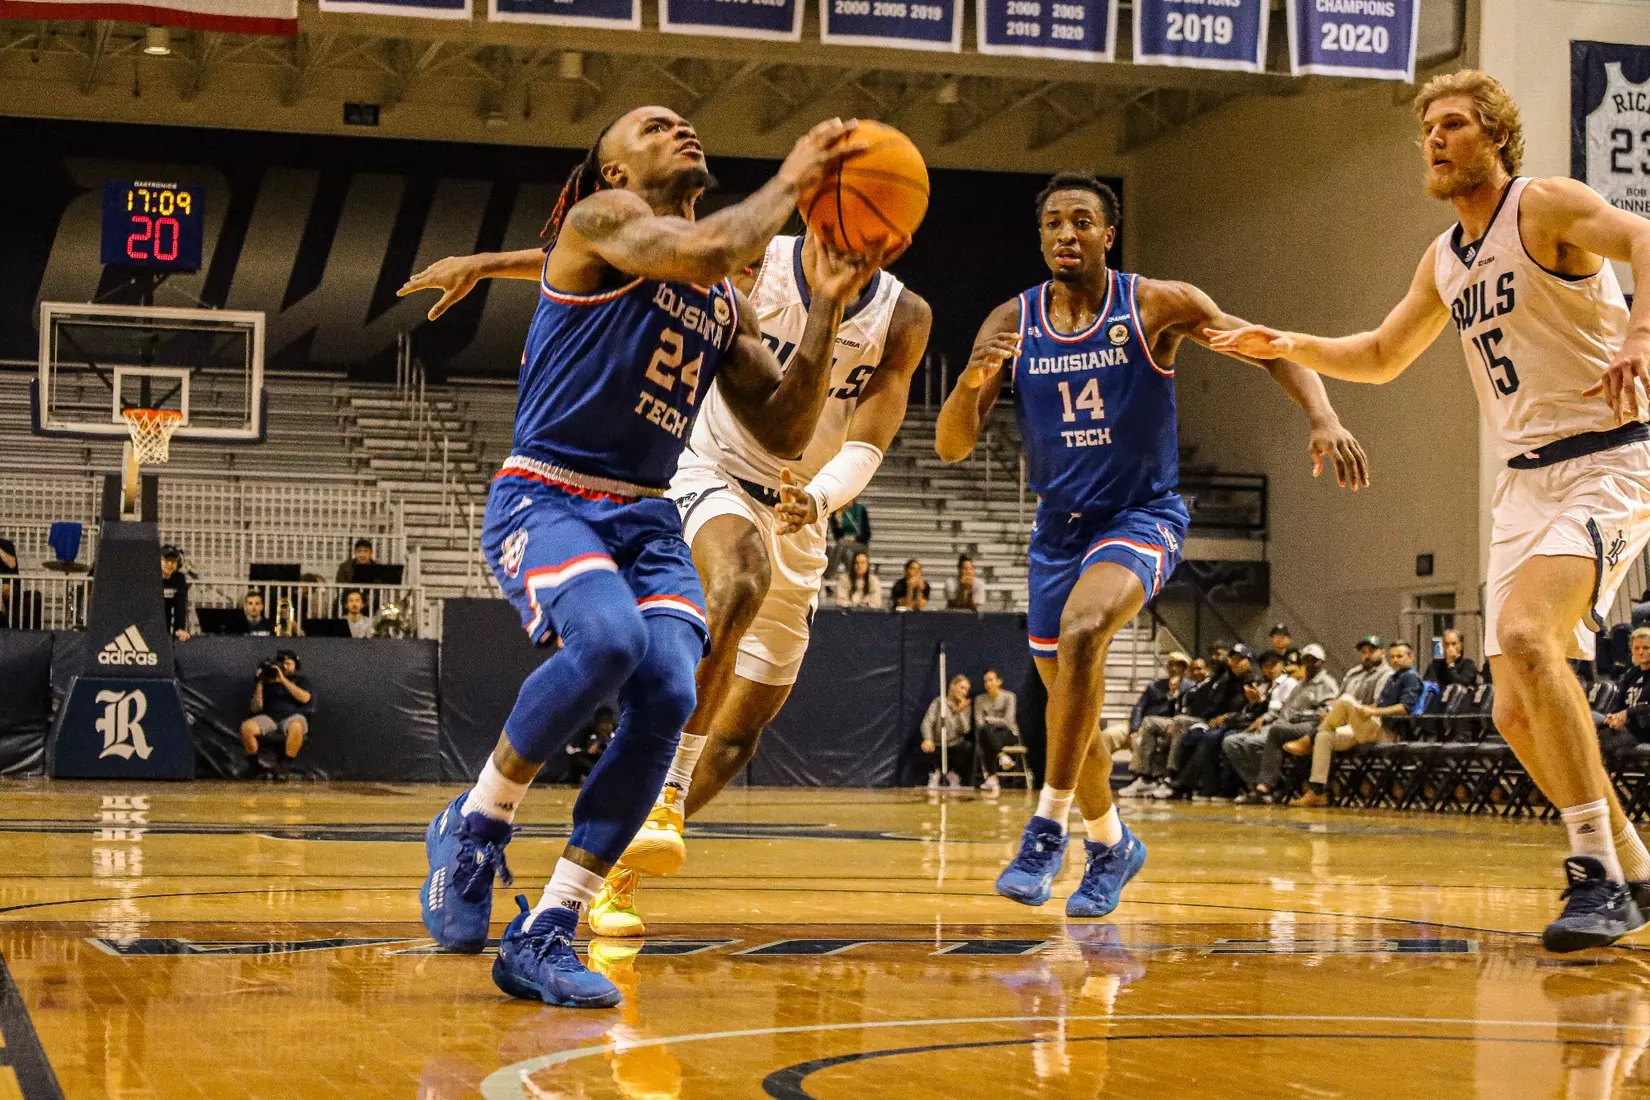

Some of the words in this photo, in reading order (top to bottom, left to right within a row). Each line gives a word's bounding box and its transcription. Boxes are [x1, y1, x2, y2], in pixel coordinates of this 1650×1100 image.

[1315, 0, 1396, 17] CHAMPIONS
[1166, 12, 1233, 45] 2019
[1320, 22, 1389, 54] 2020
[1612, 92, 1650, 114] RIC
[127, 188, 192, 216] 17:09
[1626, 187, 1647, 197] BOB
[126, 215, 180, 261] 20
[645, 327, 704, 406] 24
[1028, 347, 1129, 375] LOUISIANA
[1472, 327, 1520, 400] 15
[634, 390, 689, 439] TECH
[1057, 377, 1105, 422] 14
[1061, 427, 1113, 448] TECH
[97, 650, 158, 666] adidas
[95, 688, 154, 761] R
